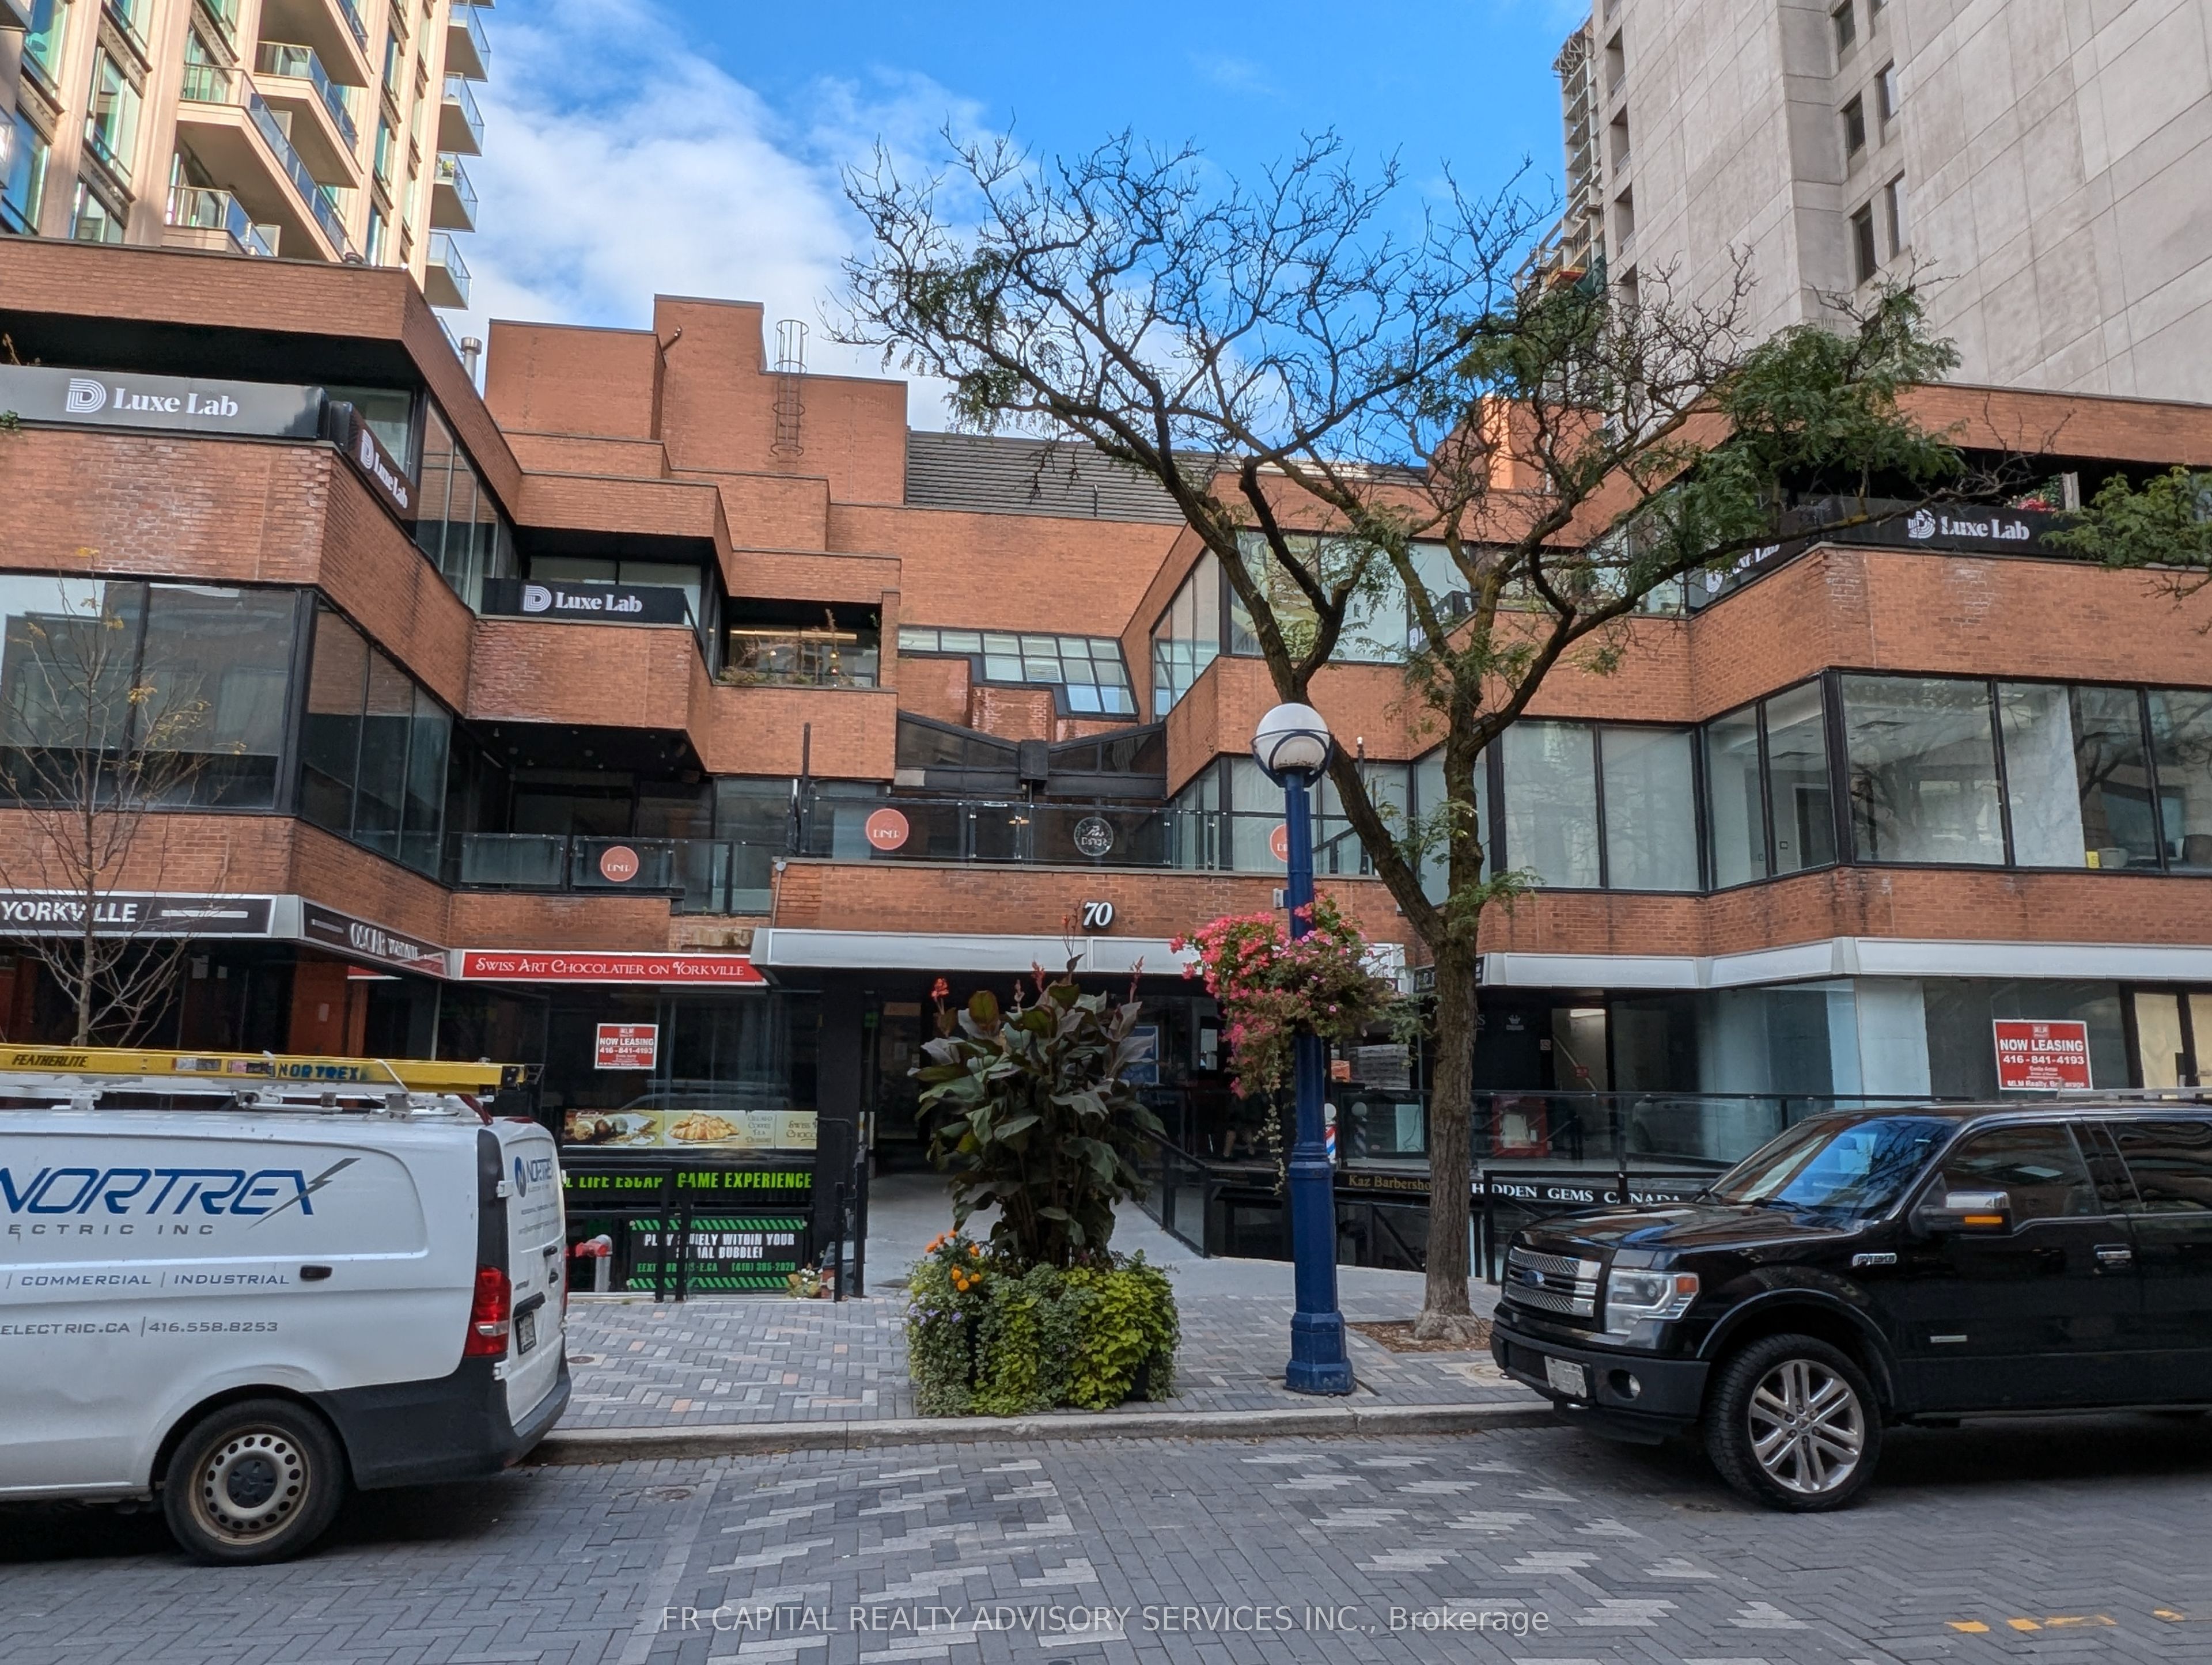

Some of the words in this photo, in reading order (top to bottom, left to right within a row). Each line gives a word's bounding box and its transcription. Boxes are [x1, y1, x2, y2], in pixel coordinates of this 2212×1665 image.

[113, 388, 180, 412] Luxe
[185, 393, 238, 417] Lab
[374, 452, 393, 491] Luxe
[393, 476, 408, 509] Lab
[1941, 516, 1988, 537] Luxe
[1991, 519, 2029, 540] Lab
[555, 591, 602, 610] Luxe
[605, 594, 642, 612] Lab
[1, 901, 138, 922] YORKVLLE
[1083, 902, 1113, 926] 70
[1999, 1039, 2028, 1050] NOW
[2031, 1040, 2083, 1052] LEASING
[678, 1173, 718, 1188] GAME
[724, 1173, 812, 1189] EXPERIENCE
[1349, 1175, 1371, 1186] Kaz
[1374, 1176, 1430, 1190] Barbersho
[0, 1161, 347, 1222] NORTREX
[1472, 1184, 1537, 1198] HDDEN
[1548, 1188, 1593, 1203] GEMS
[1604, 1192, 1680, 1204] CNADA
[8, 1224, 135, 1236] ECTRIC
[158, 1224, 214, 1235] INC
[645, 1234, 674, 1246] PLY
[766, 1234, 794, 1245] YOUR
[21, 1275, 151, 1286] COMMERCIAL
[174, 1274, 290, 1285] INDUSTRIAL
[0, 1322, 130, 1336] ELECTRIC.CA
[149, 1322, 278, 1333] 416.558.8253
